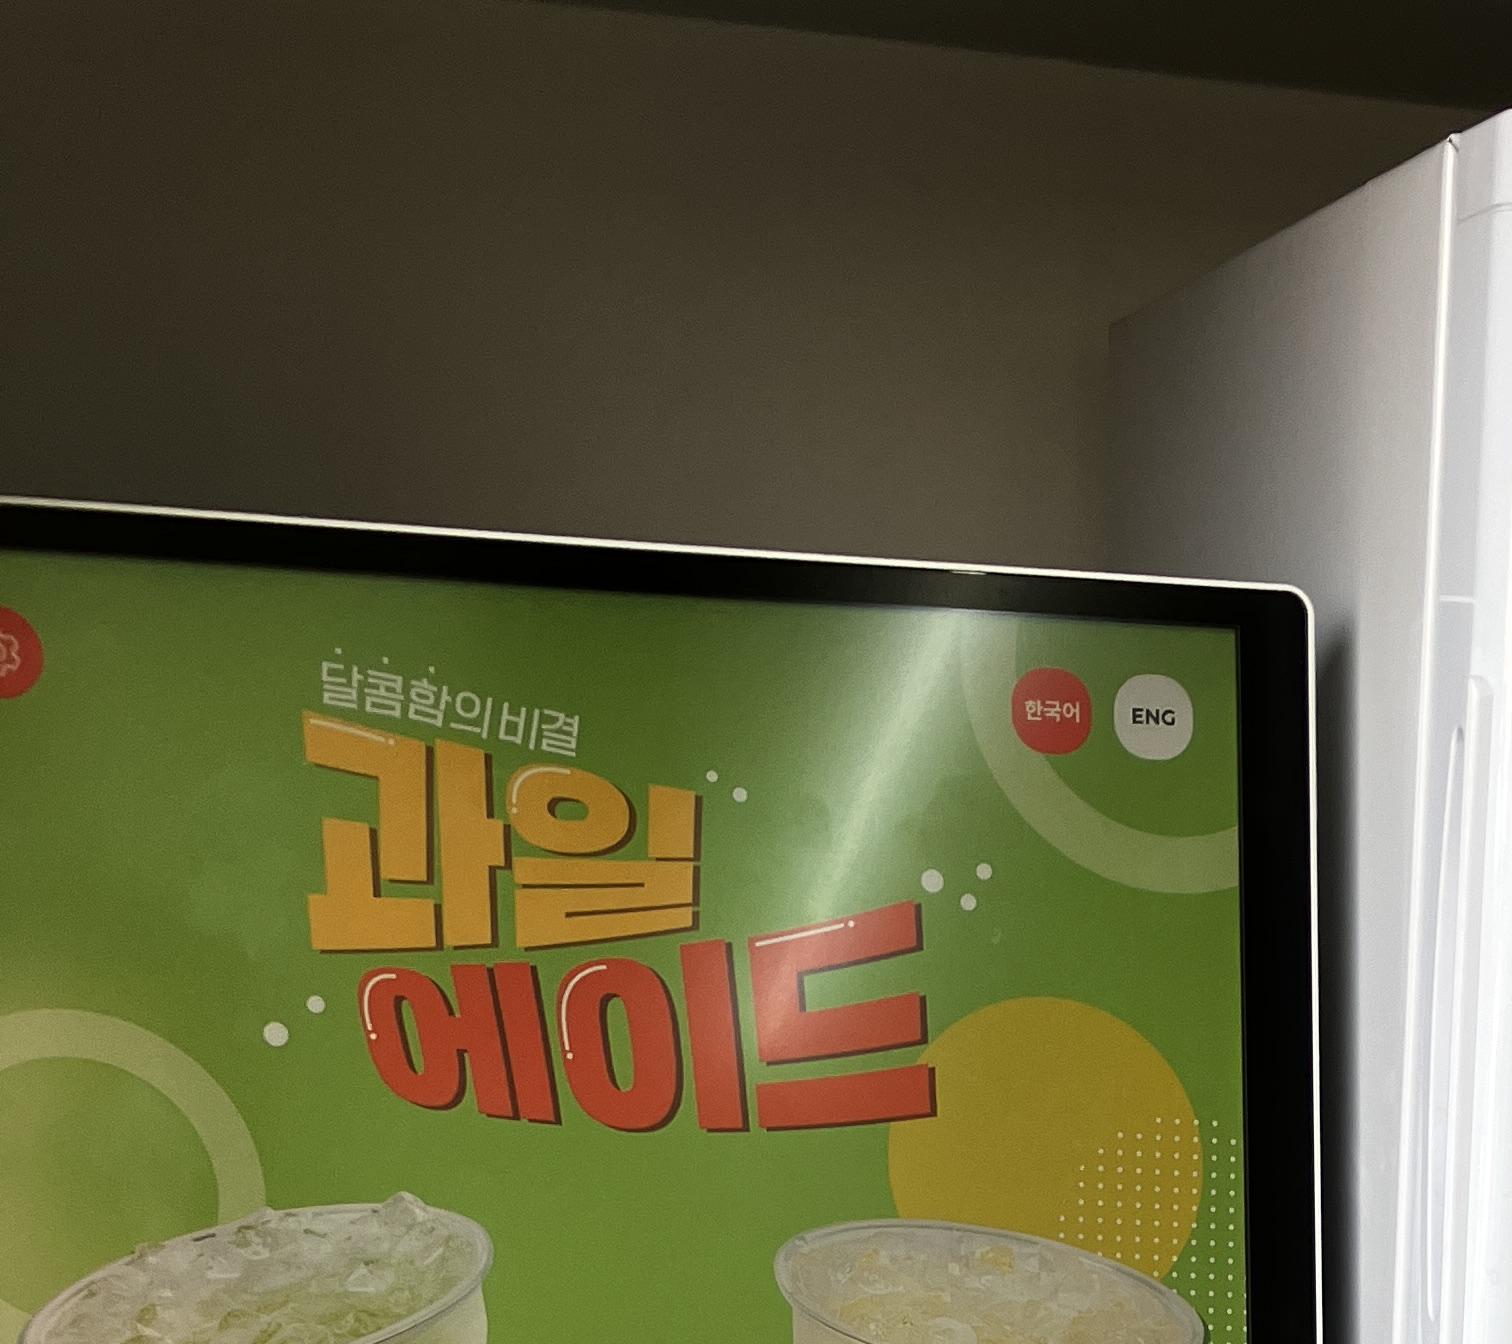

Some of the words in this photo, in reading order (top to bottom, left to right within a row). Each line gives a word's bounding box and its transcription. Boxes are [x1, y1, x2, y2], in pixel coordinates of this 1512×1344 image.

[1024, 698, 1081, 723] 한국어
[1131, 705, 1176, 728] ENG
[303, 710, 702, 953] 과일
[357, 900, 937, 1133] 에이드
